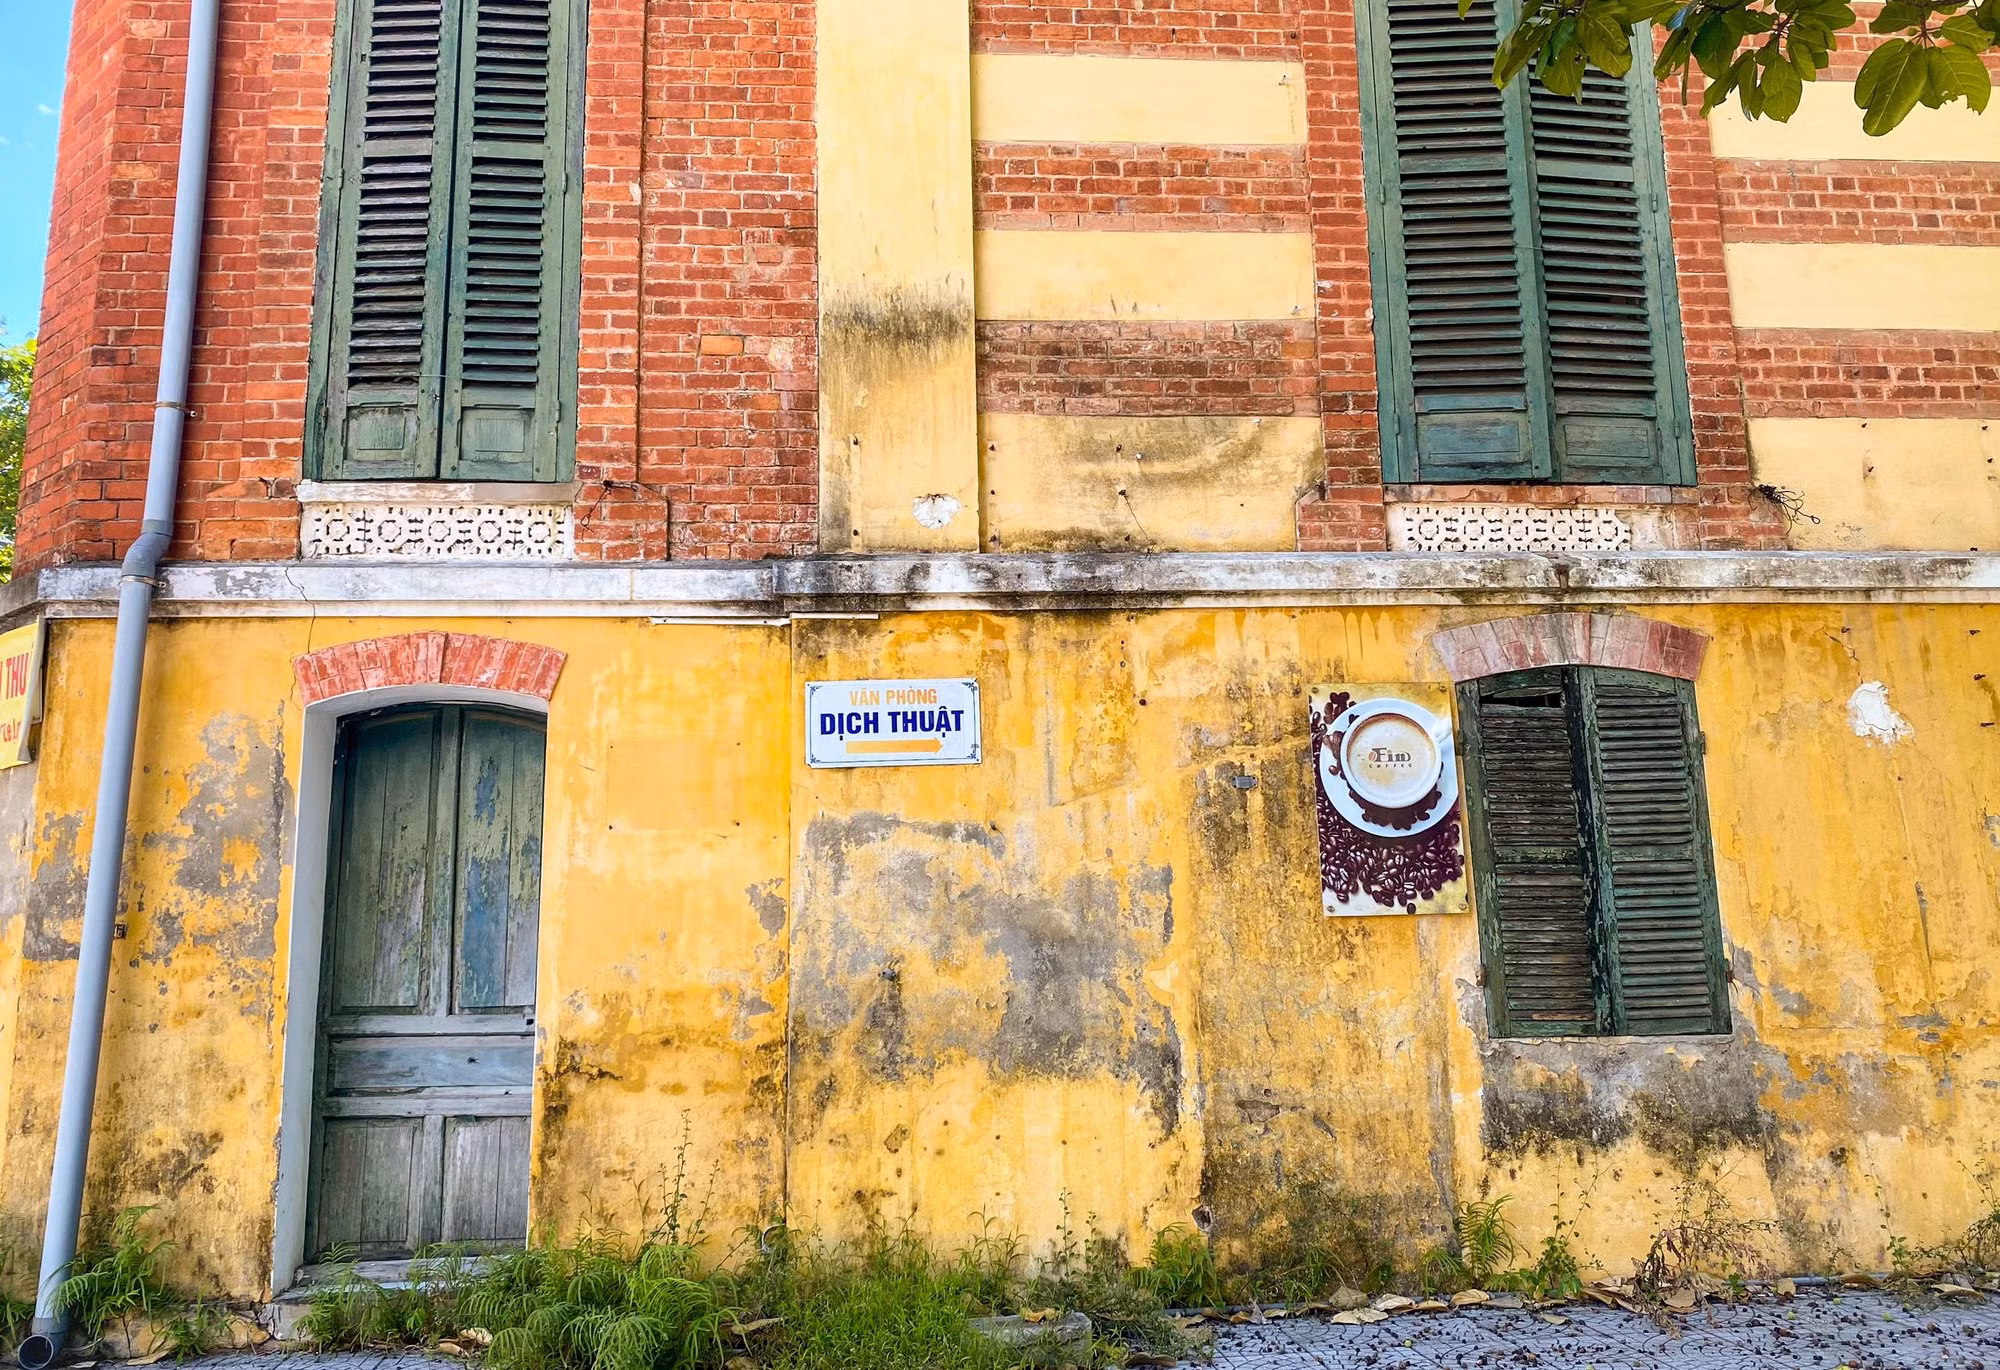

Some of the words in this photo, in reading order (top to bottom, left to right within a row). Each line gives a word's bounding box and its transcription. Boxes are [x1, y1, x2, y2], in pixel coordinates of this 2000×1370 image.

[5, 651, 32, 700] THU
[849, 687, 880, 706] VĂN
[885, 686, 938, 705] PHÒNG
[820, 712, 879, 741] DỊCH
[887, 706, 964, 738] THUẬT
